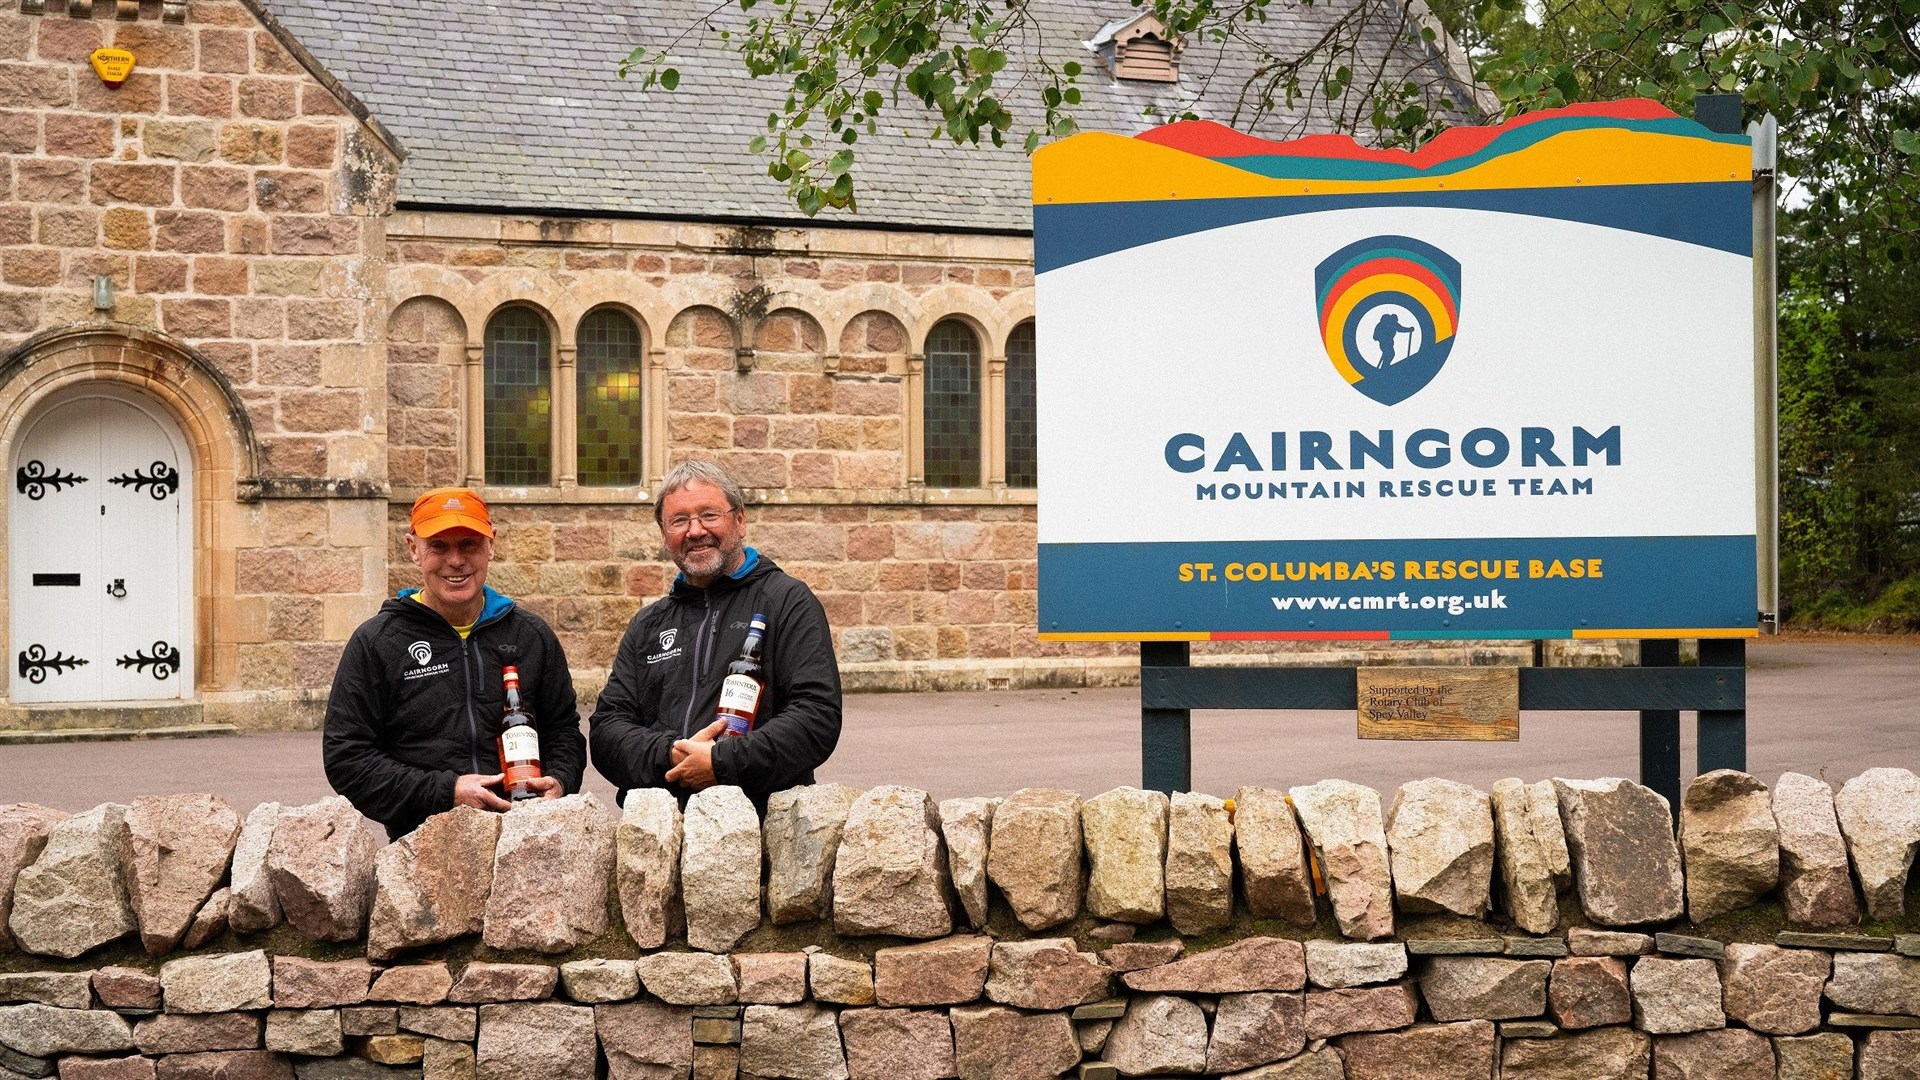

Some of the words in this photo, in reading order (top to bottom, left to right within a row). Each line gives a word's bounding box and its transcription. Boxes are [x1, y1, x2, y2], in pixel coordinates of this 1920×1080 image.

[1164, 425, 1622, 474] CAIRNGORM
[1196, 480, 1366, 501] MOUNTAIN
[1379, 479, 1497, 498] RESCUE
[1508, 477, 1594, 496] TEAM
[1178, 562, 1217, 582] ST.
[1224, 560, 1396, 582] COLUMBA'S
[1404, 559, 1520, 580] RESCUE
[1529, 558, 1603, 579] BASE
[1271, 589, 1508, 616] www.cmrt.org.uk
[646, 648, 682, 660] CAIRNGORM
[403, 662, 449, 677] CAIRNGORM
[725, 688, 734, 698] 16
[1369, 685, 1419, 696] Supported
[1422, 685, 1434, 696] by
[1437, 685, 1453, 695] the
[1369, 697, 1404, 709] Rotary
[1405, 697, 1429, 707] Club
[1432, 696, 1445, 707] of
[1369, 709, 1394, 721] Spey
[1396, 709, 1428, 721] Valley
[508, 741, 518, 751] 21
